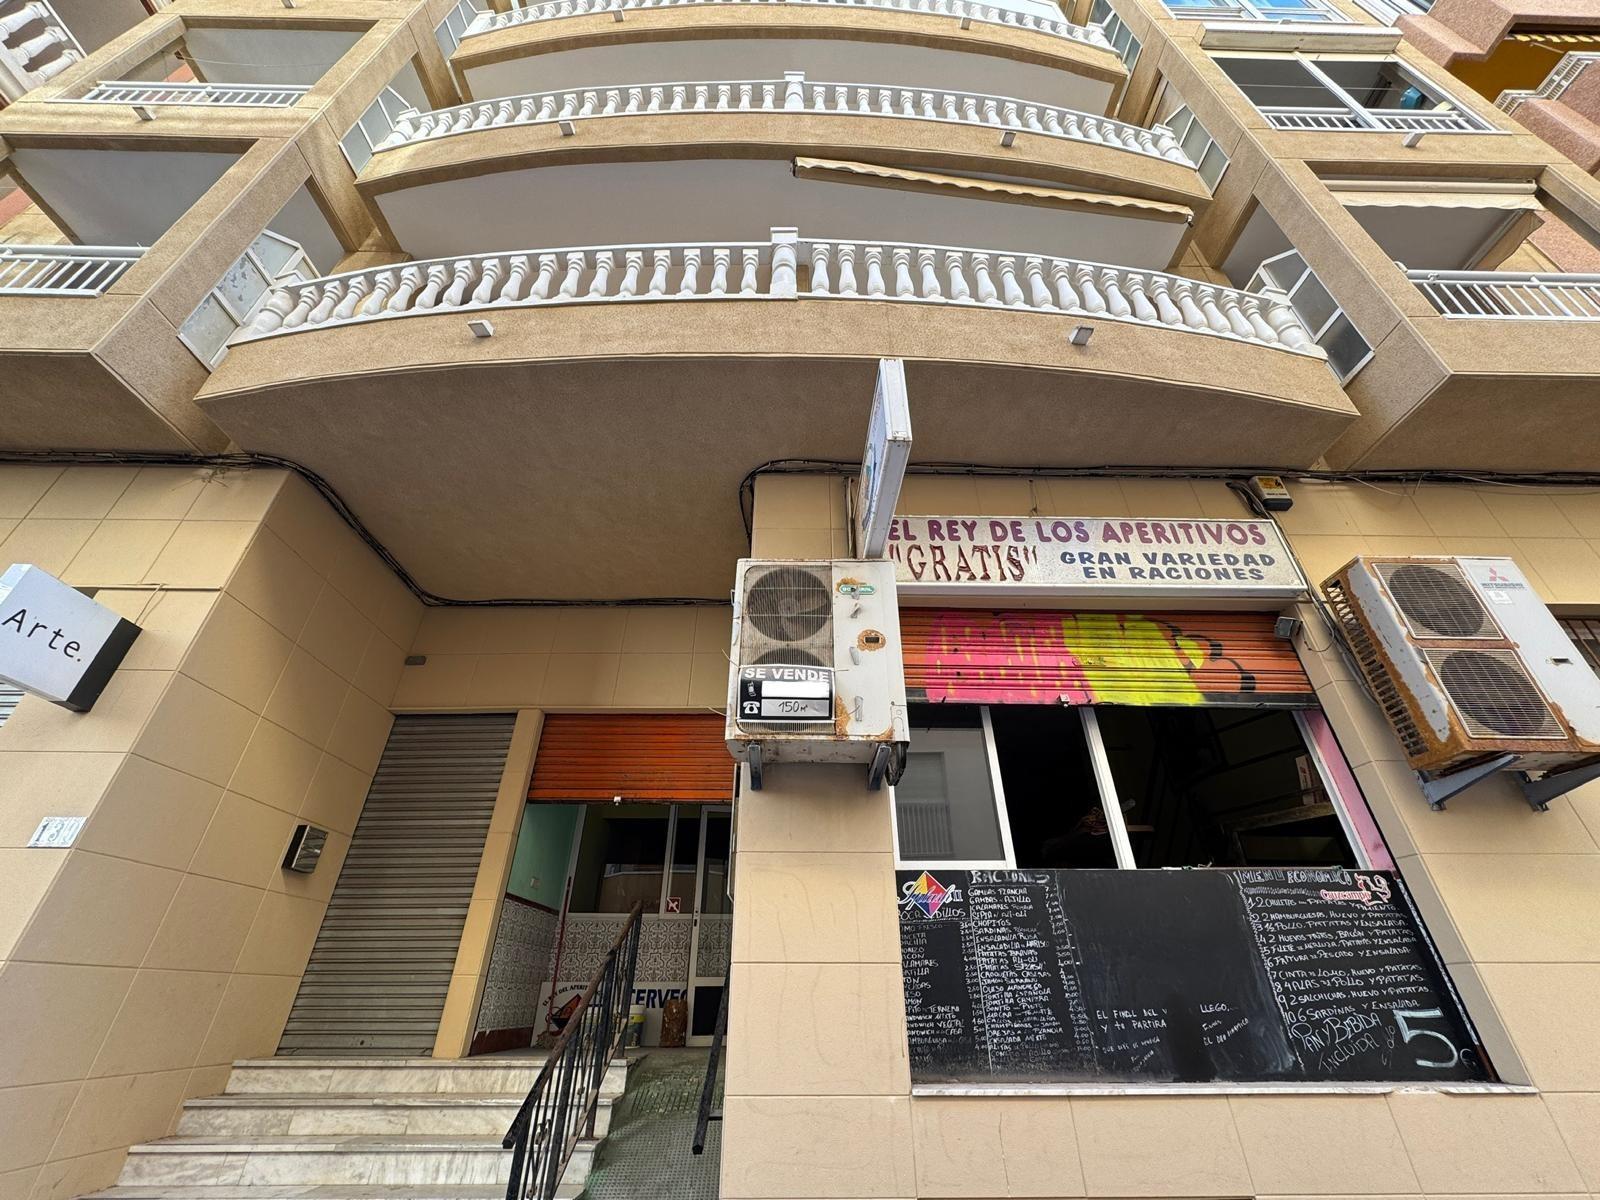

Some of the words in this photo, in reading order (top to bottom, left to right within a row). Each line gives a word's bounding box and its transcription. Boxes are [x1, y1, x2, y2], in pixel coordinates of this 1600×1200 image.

[888, 519, 917, 541] EL
[927, 519, 977, 542] REY
[989, 519, 1026, 542] DE
[1035, 520, 1090, 544] LOS
[1101, 522, 1267, 546] APERITIVOS
[1060, 551, 1132, 566] GRAN
[1144, 551, 1275, 567] VARIEDAD
[1084, 565, 1116, 580] EN
[1130, 566, 1265, 581] RACIONES
[1, 608, 82, 663] Arte.
[744, 668, 767, 679] SE
[771, 668, 830, 682] VENDE
[1096, 1010, 1108, 1019] EL
[1298, 1008, 1306, 1022] 6
